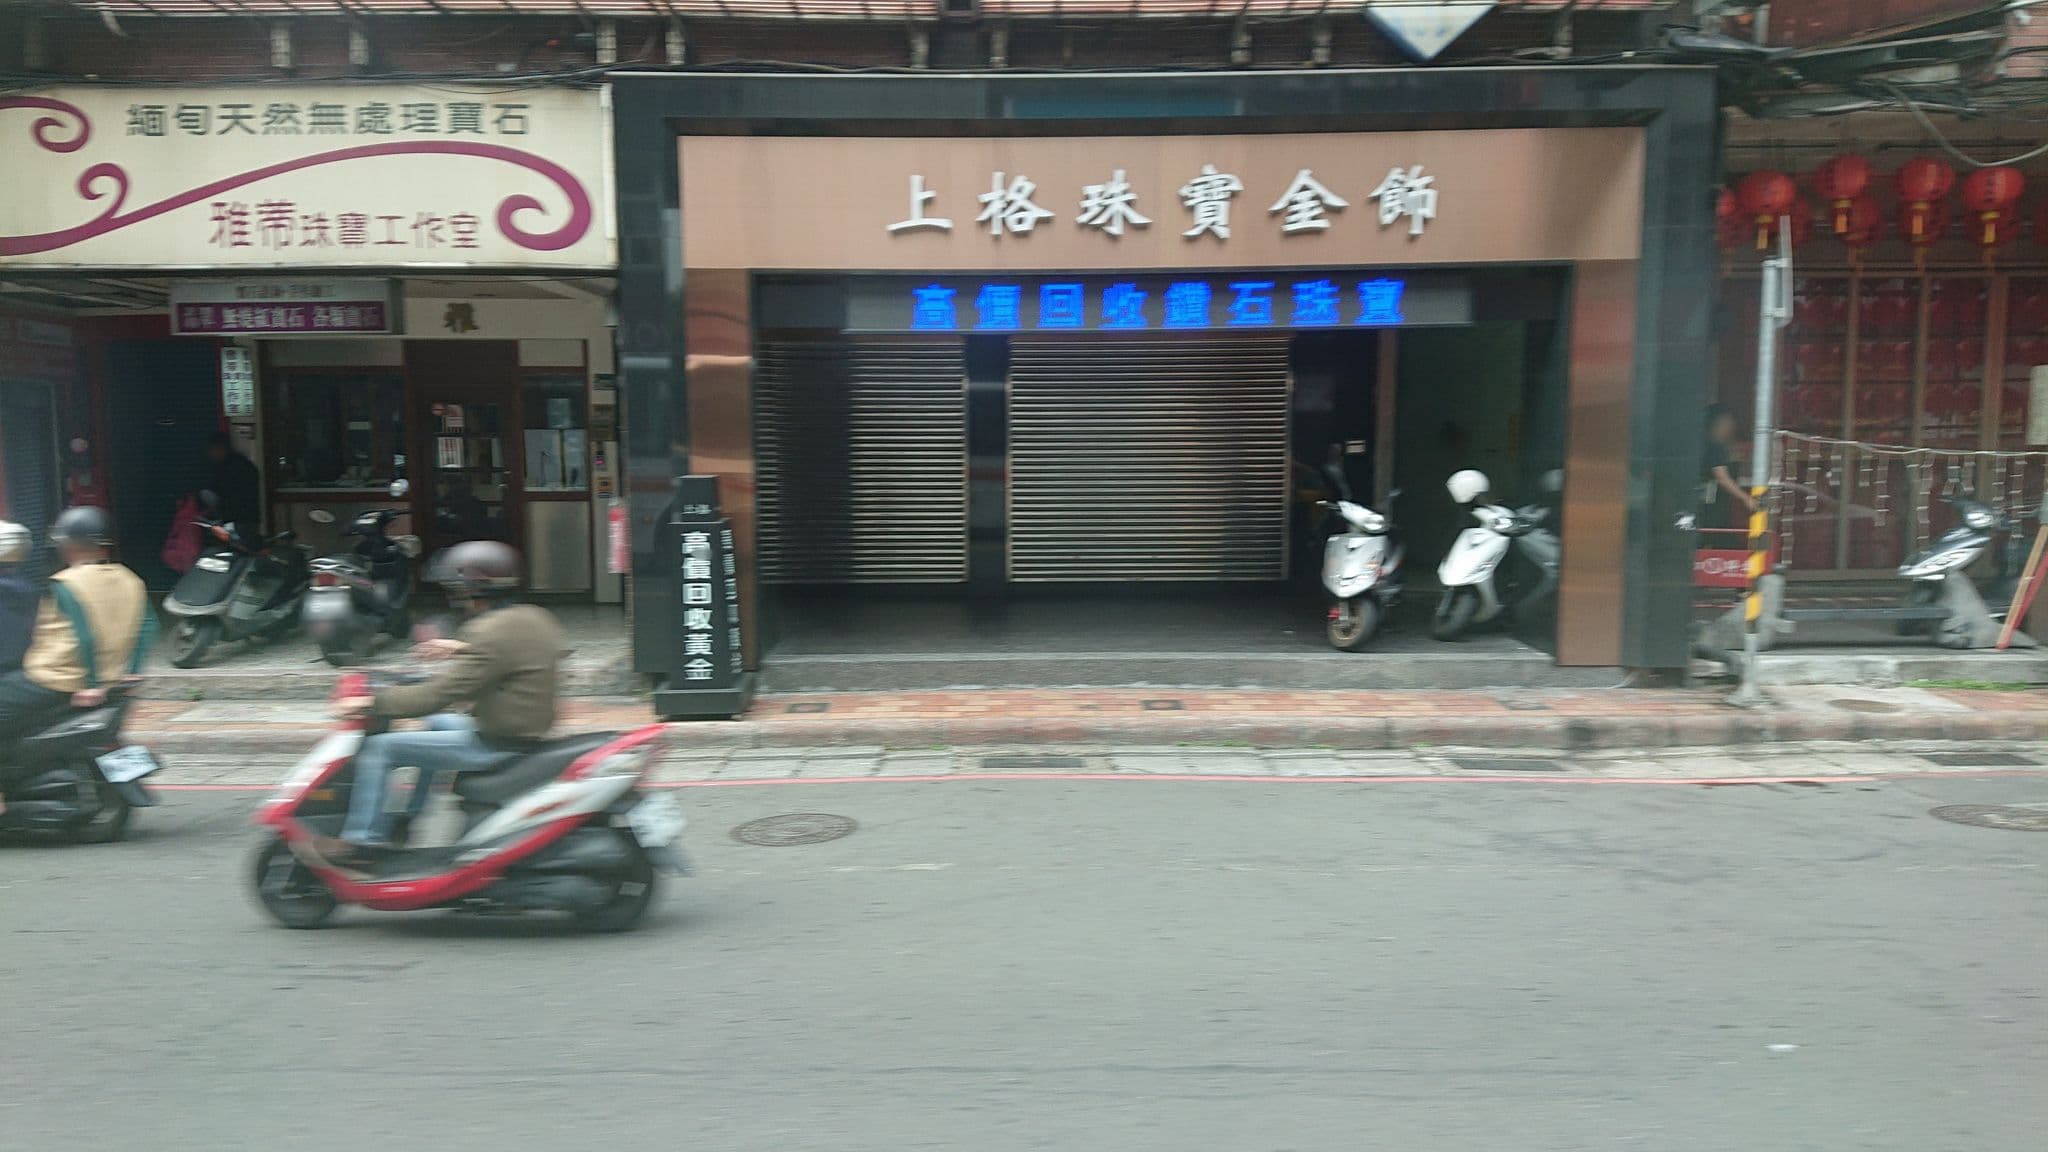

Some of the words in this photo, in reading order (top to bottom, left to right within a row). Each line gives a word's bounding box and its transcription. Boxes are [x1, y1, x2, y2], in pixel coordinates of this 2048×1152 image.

[126, 102, 531, 137] 緬甸天然無處理寶石
[209, 200, 481, 250] 雅蒂珠寶工作室
[887, 163, 1440, 240] 上格珠寶金飾
[911, 278, 1406, 331] 高價回收鑽石珠寶
[679, 530, 715, 681] 高價回收黃金
